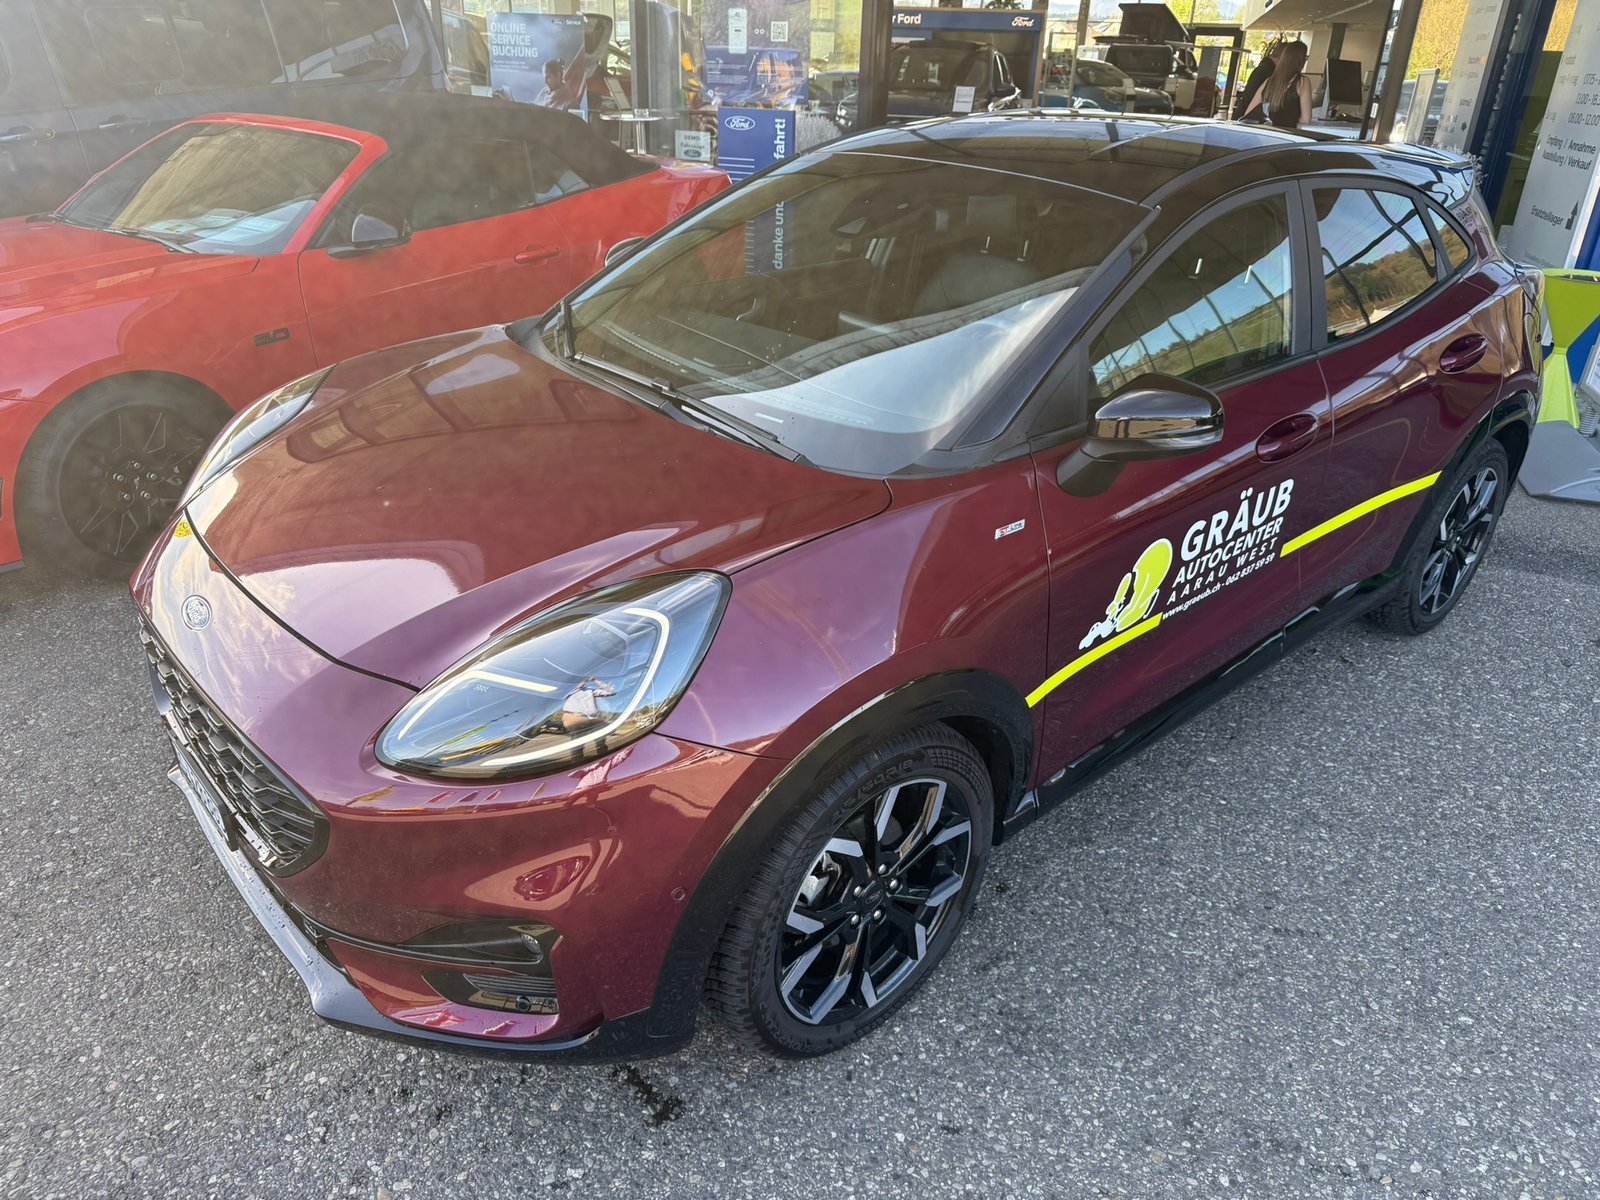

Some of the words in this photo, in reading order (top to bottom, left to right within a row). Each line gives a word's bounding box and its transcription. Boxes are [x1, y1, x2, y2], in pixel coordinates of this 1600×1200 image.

[897, 13, 921, 25] Ford
[1011, 16, 1034, 28] Ford
[490, 22, 526, 33] ONLINE
[491, 34, 531, 45] SERVICE
[492, 46, 538, 58] BUCHUNG
[729, 117, 751, 128] Ford
[773, 118, 785, 160] fahrt!
[1567, 139, 1596, 155] Annahme
[1567, 156, 1593, 171] Verkauf
[772, 227, 784, 269] danke
[1180, 478, 1294, 561] GRÄUB
[1171, 516, 1284, 588] AUTOCENTER
[1166, 562, 1228, 606] AARAU
[1236, 537, 1278, 568] WEST
[1162, 582, 1221, 620] www.graeub.ch
[1225, 573, 1240, 586] 062
[1240, 566, 1254, 578] 837
[1254, 558, 1265, 571] 59
[1264, 552, 1276, 565] 59
